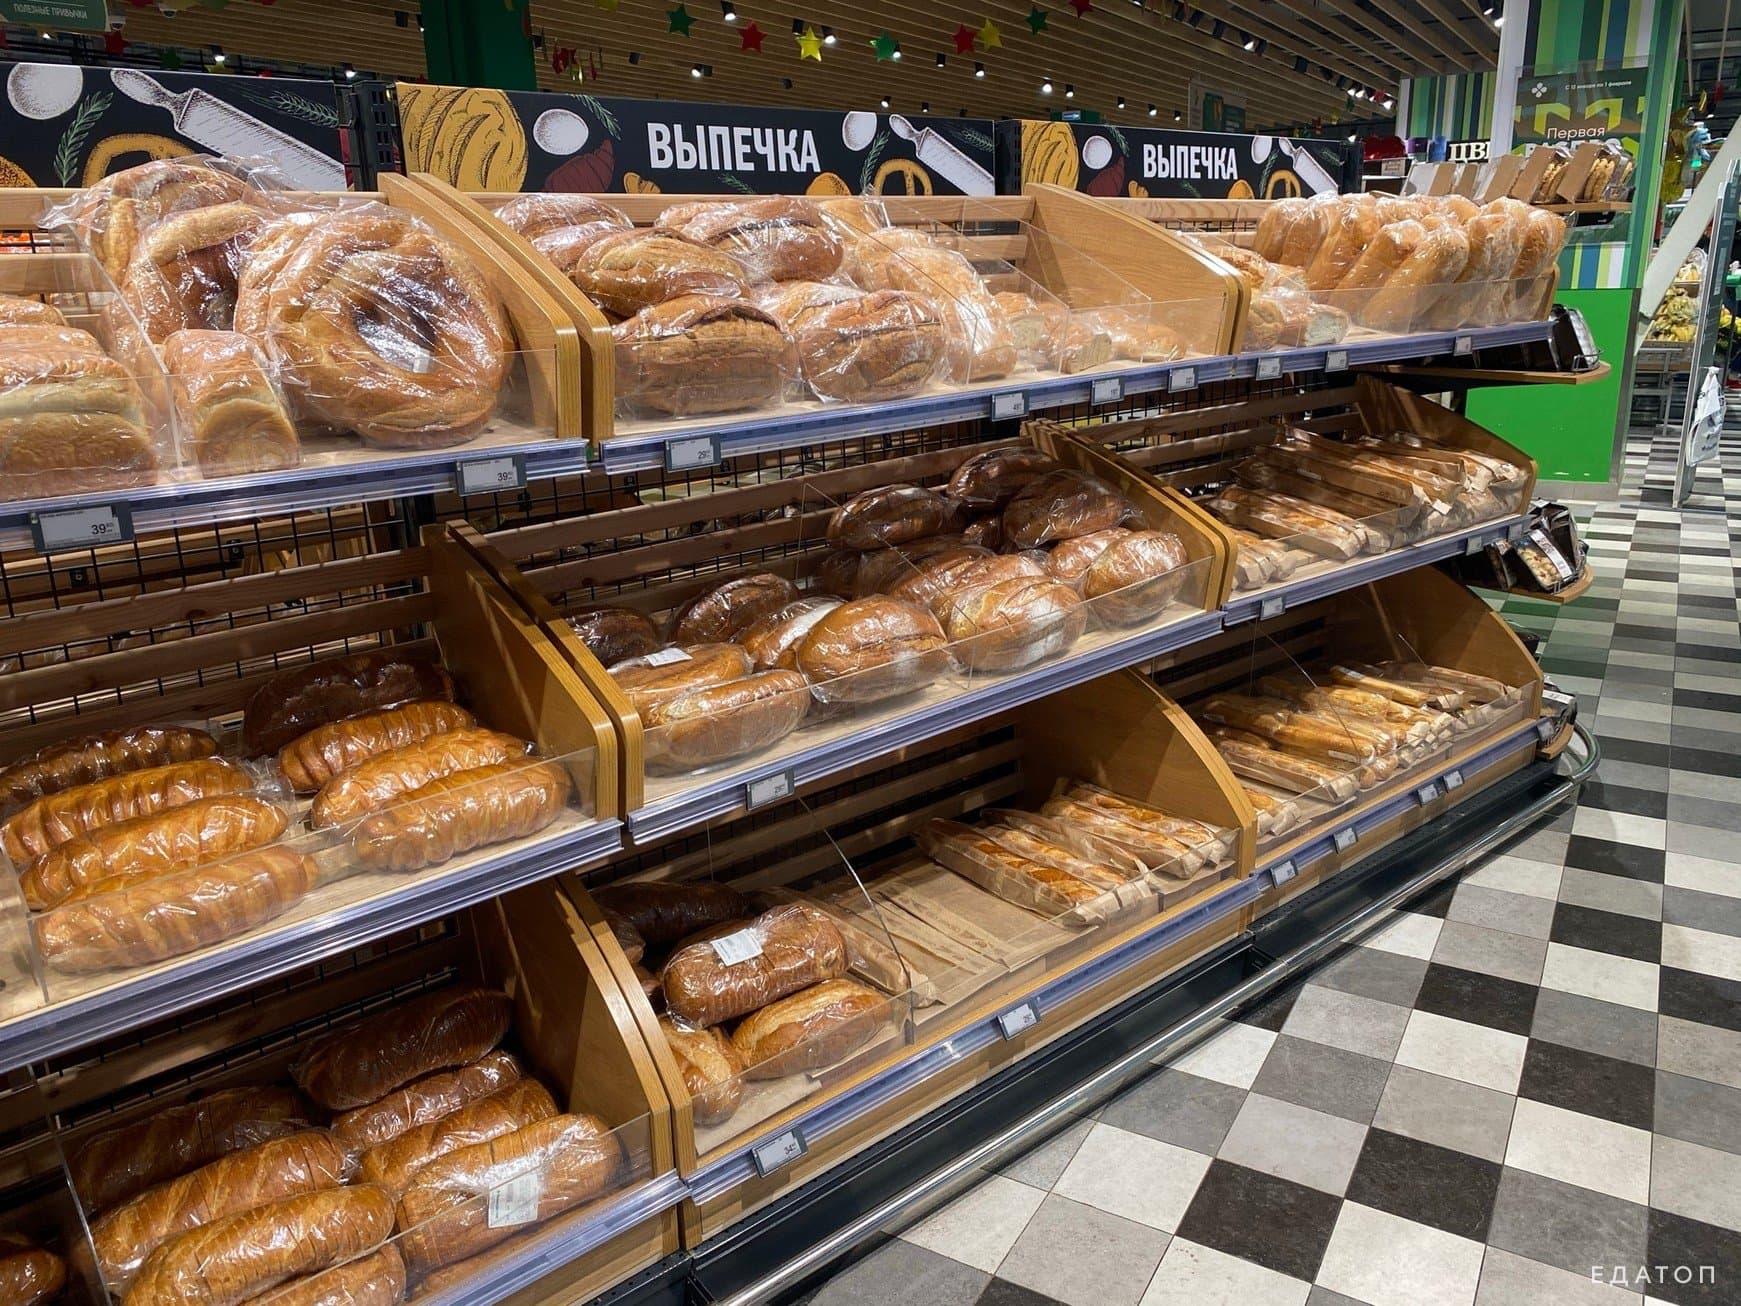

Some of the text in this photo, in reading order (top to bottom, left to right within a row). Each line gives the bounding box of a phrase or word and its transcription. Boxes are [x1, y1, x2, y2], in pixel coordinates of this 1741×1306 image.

[52, 7, 88, 19] ПРИВЫЧКИ
[1547, 127, 1606, 140] Первая
[647, 122, 821, 173] ВЫПЕЧКА
[1143, 143, 1238, 180] ВЫПЕЧКА
[497, 472, 508, 481] 39
[91, 523, 107, 535] 39
